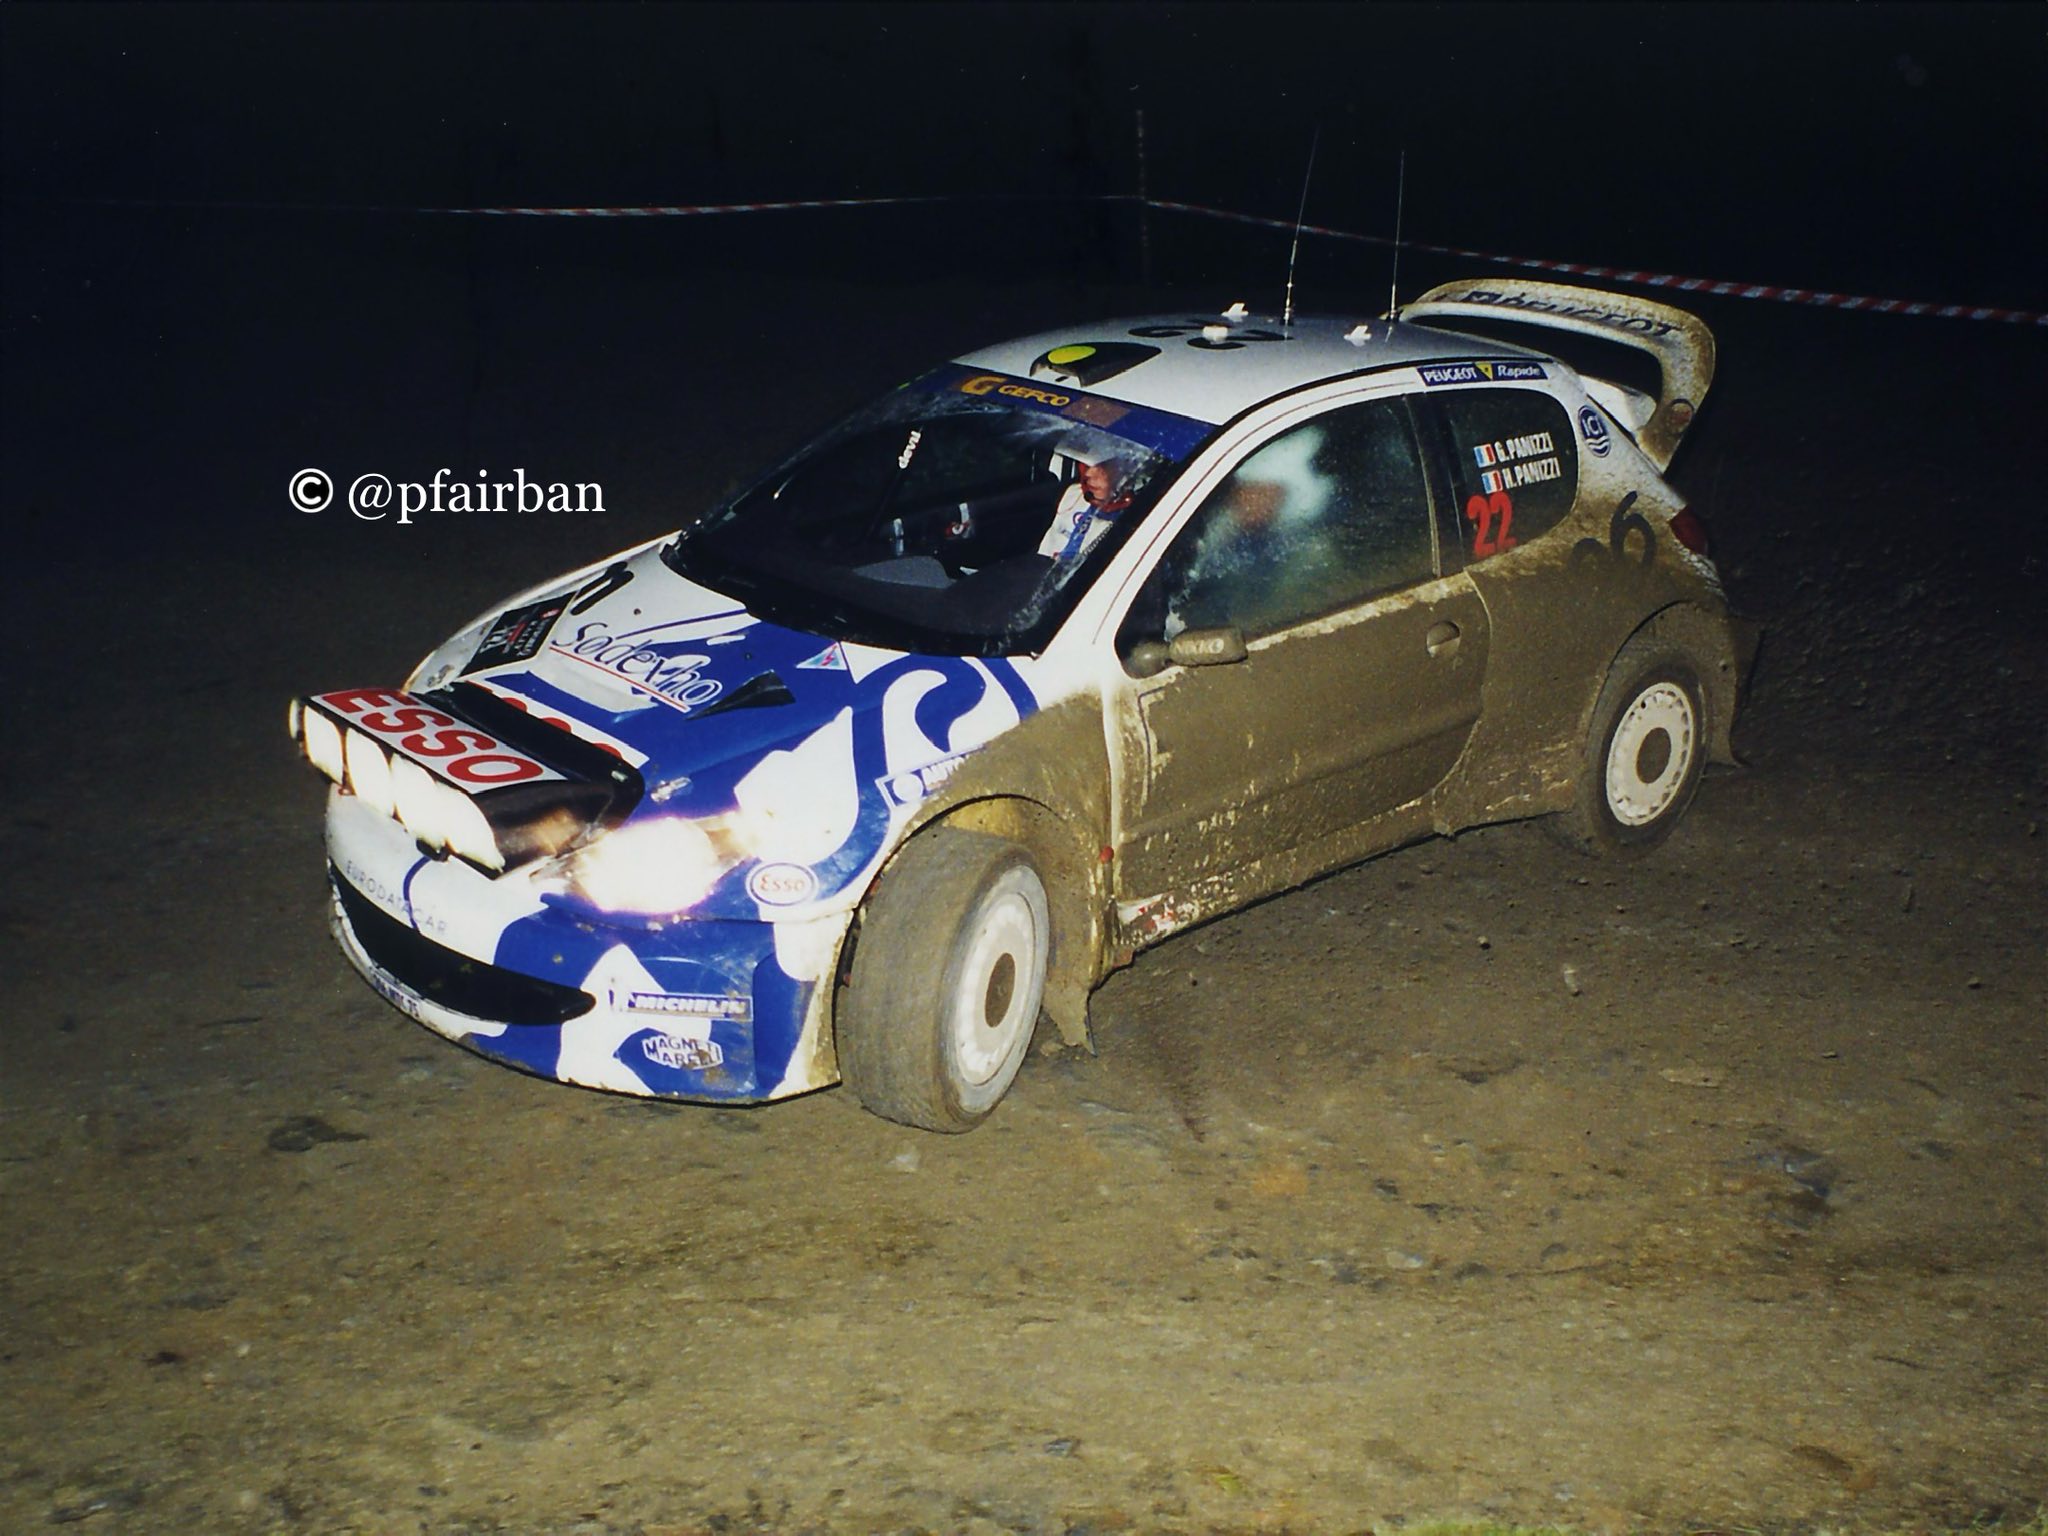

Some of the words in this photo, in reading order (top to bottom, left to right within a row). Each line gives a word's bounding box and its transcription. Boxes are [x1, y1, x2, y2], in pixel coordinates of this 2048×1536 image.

[1423, 366, 1478, 383] PEUGEOT
[1497, 364, 1541, 379] Rapide
[998, 384, 1071, 407] GEFCO
[1466, 491, 1518, 557] 22
[551, 622, 723, 706] Sodexho
[321, 689, 544, 783] ESSO
[760, 873, 805, 892] Esso
[635, 996, 747, 1014] MICHELIN
[645, 1036, 721, 1055] MAGNETI
